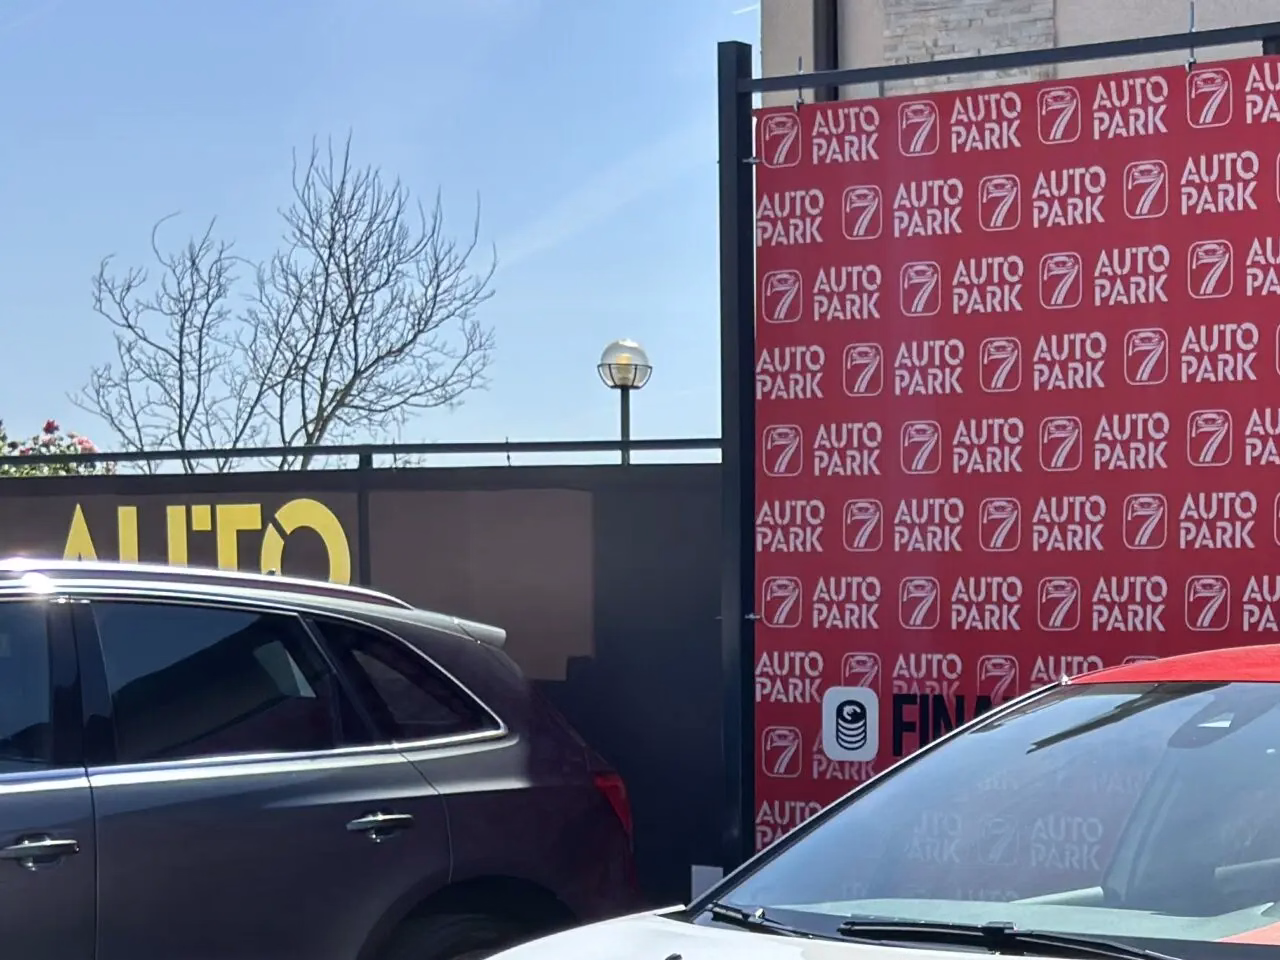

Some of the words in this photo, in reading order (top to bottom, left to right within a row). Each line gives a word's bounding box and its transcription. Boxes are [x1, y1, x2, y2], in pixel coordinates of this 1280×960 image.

[952, 91, 1021, 123] AUTO
[1093, 75, 1168, 110] AUTO
[812, 106, 879, 136] AUTO
[1094, 104, 1168, 140] PARK
[813, 133, 879, 164] PARK
[952, 120, 1021, 153] PARK
[1180, 150, 1259, 185] AUTO
[893, 178, 963, 209] AUTO
[1032, 166, 1106, 199] AUTO
[757, 189, 824, 219] AUTO
[1033, 195, 1104, 228] PARK
[1181, 181, 1257, 215] PARK
[757, 216, 823, 247] PARK
[894, 206, 962, 237] PARK
[952, 255, 1024, 286] AUTO
[1094, 244, 1170, 277] AUTO
[813, 265, 881, 293] AUTO
[1095, 274, 1168, 306] PARK
[814, 292, 880, 321] PARK
[953, 284, 1022, 314] PARK
[1033, 332, 1106, 362] AUTO
[1180, 322, 1259, 353] AUTO
[756, 345, 825, 373] AUTO
[894, 339, 964, 367] AUTO
[1182, 352, 1257, 383] PARK
[756, 372, 823, 400] PARK
[895, 367, 963, 395] PARK
[1034, 360, 1104, 391] PARK
[814, 422, 882, 448] AUTO
[953, 418, 1024, 445] AUTO
[1094, 412, 1169, 441] AUTO
[814, 449, 880, 476] PARK
[953, 446, 1022, 473] PARK
[1095, 441, 1167, 470] PARK
[756, 500, 825, 525] AUTO
[894, 498, 964, 524] AUTO
[1032, 495, 1106, 523] AUTO
[1179, 491, 1257, 520] AUTO
[756, 527, 822, 552] PARK
[895, 525, 962, 552] PARK
[1033, 524, 1104, 551] PARK
[1180, 520, 1255, 549] PARK
[813, 576, 880, 602] AUTO
[952, 576, 1022, 603] AUTO
[1092, 576, 1167, 602] AUTO
[813, 603, 878, 629] PARK
[952, 604, 1020, 630] PARK
[1093, 604, 1165, 631] PARK
[755, 651, 823, 676] AUTO
[893, 653, 962, 680] AUTO
[756, 677, 822, 703] PARK
